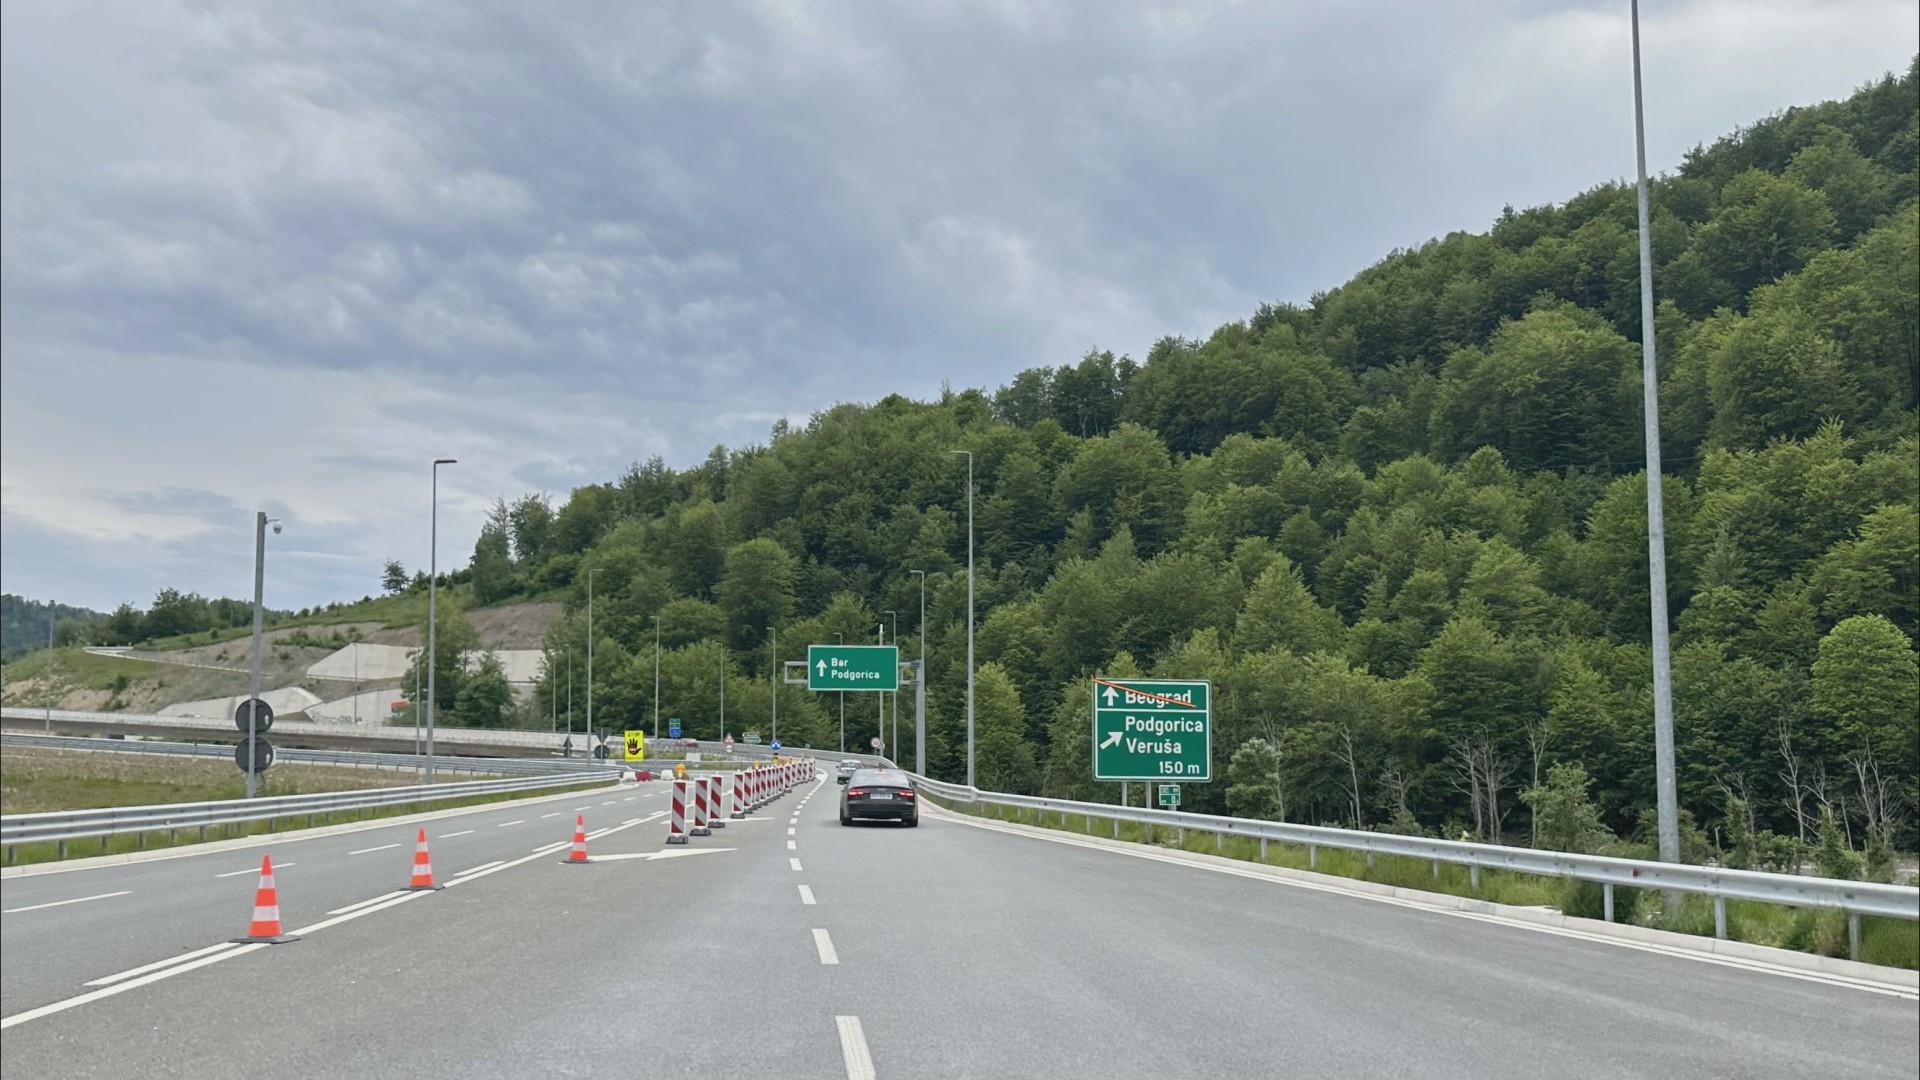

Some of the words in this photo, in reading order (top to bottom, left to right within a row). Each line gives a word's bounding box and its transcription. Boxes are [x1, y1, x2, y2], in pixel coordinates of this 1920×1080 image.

[831, 657, 848, 667] Bar
[831, 669, 880, 681] Podgorica
[1125, 690, 1191, 708] Beograd
[1125, 716, 1204, 736] Podgorica
[1126, 738, 1182, 754] Veruša
[1159, 761, 1183, 774] 150
[1187, 764, 1200, 774] m
